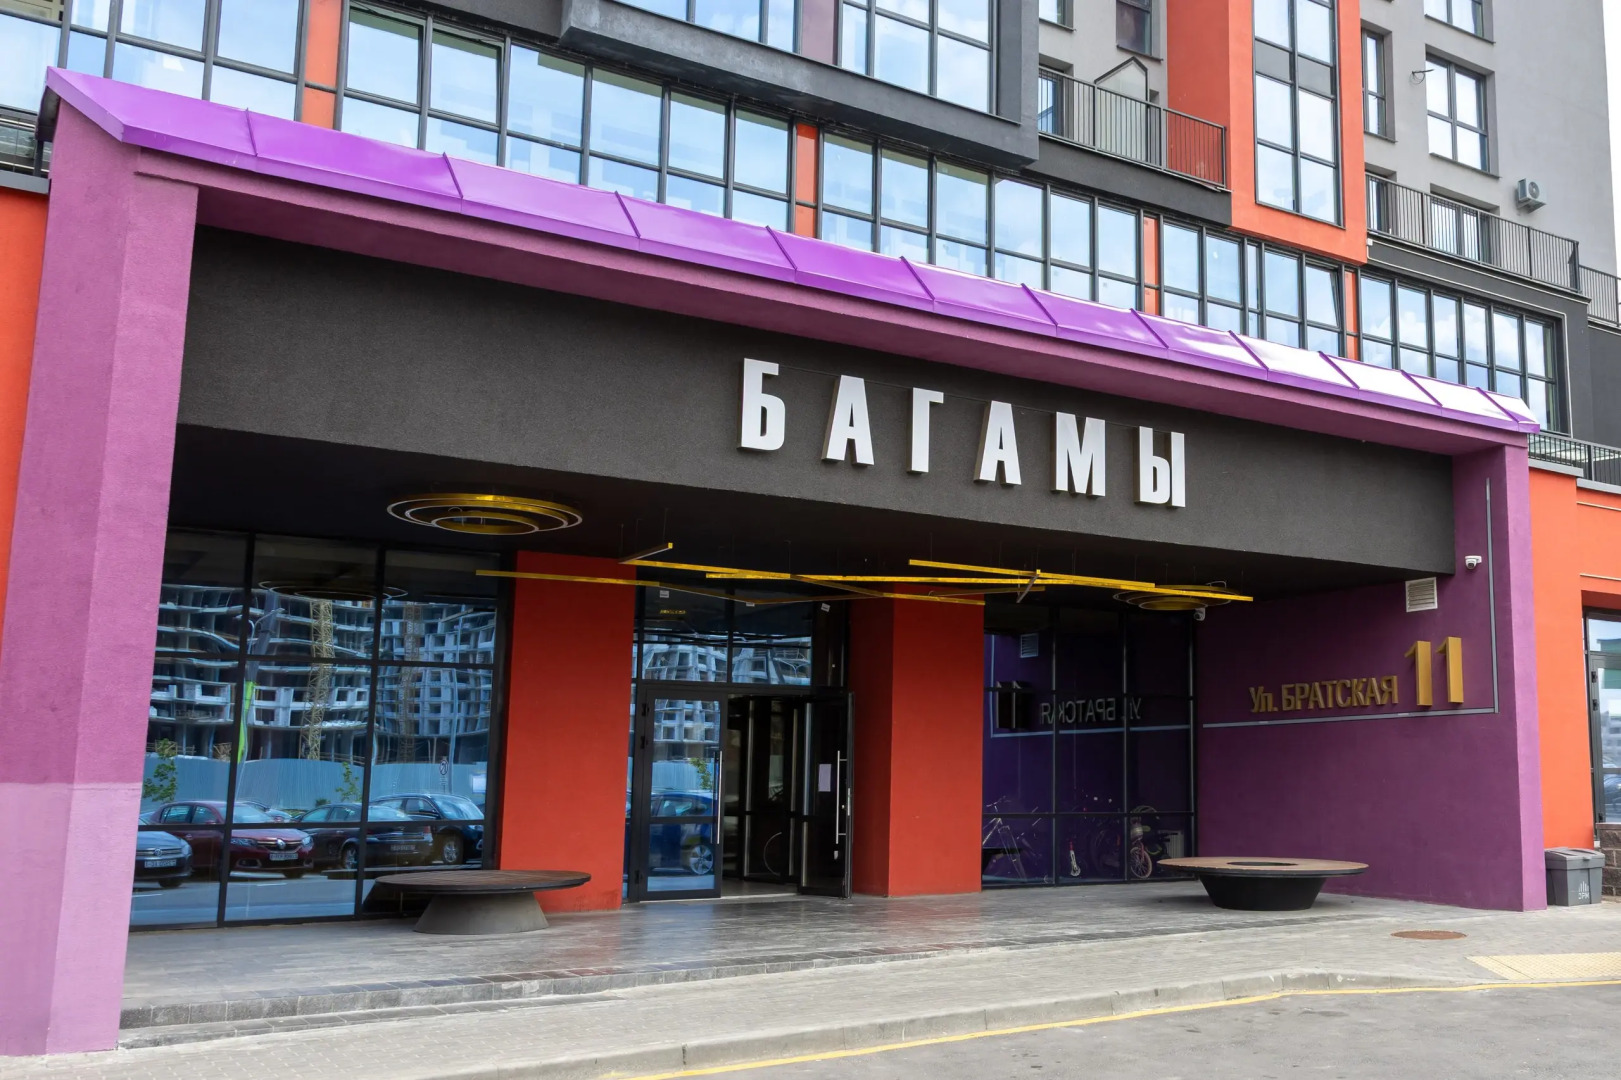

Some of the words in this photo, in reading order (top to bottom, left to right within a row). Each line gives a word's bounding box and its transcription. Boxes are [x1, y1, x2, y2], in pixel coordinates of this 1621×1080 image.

[739, 357, 1186, 508] БАГАМЫ
[1249, 685, 1278, 713] Ул.
[1281, 675, 1399, 711] БРАТСКАЯ
[1404, 636, 1464, 707] 11
